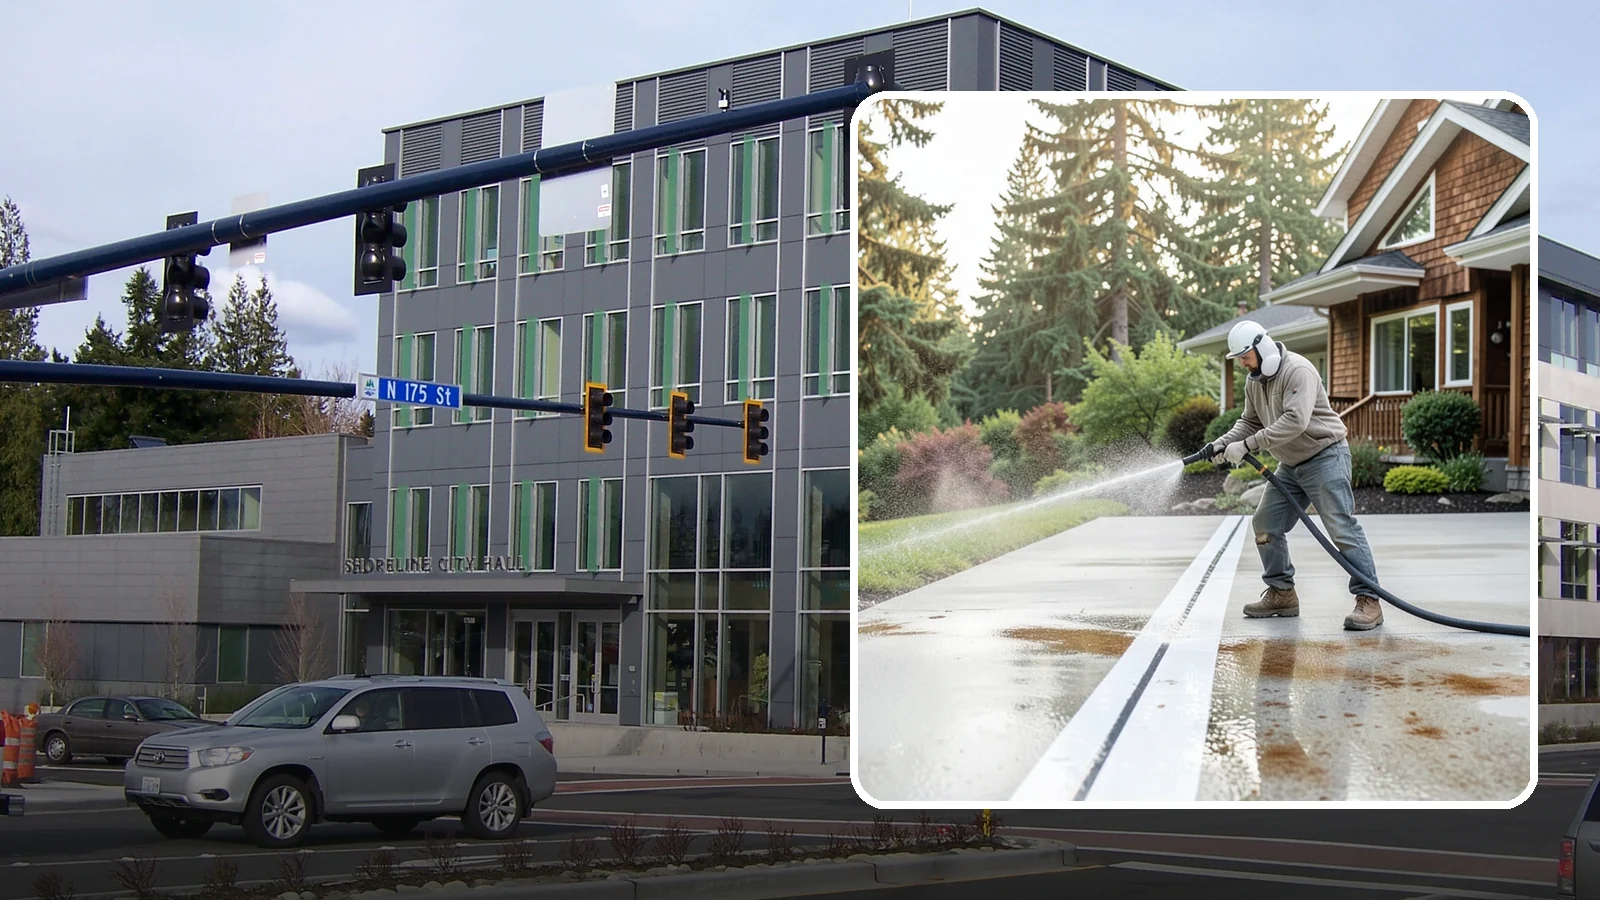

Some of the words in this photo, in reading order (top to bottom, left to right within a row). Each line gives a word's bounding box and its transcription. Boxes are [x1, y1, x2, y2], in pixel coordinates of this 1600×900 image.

[387, 380, 396, 400] N
[405, 382, 427, 403] 175
[436, 386, 451, 406] St
[344, 557, 431, 574] SHORELINE
[438, 556, 475, 572] CITY
[483, 555, 526, 571] HALL
